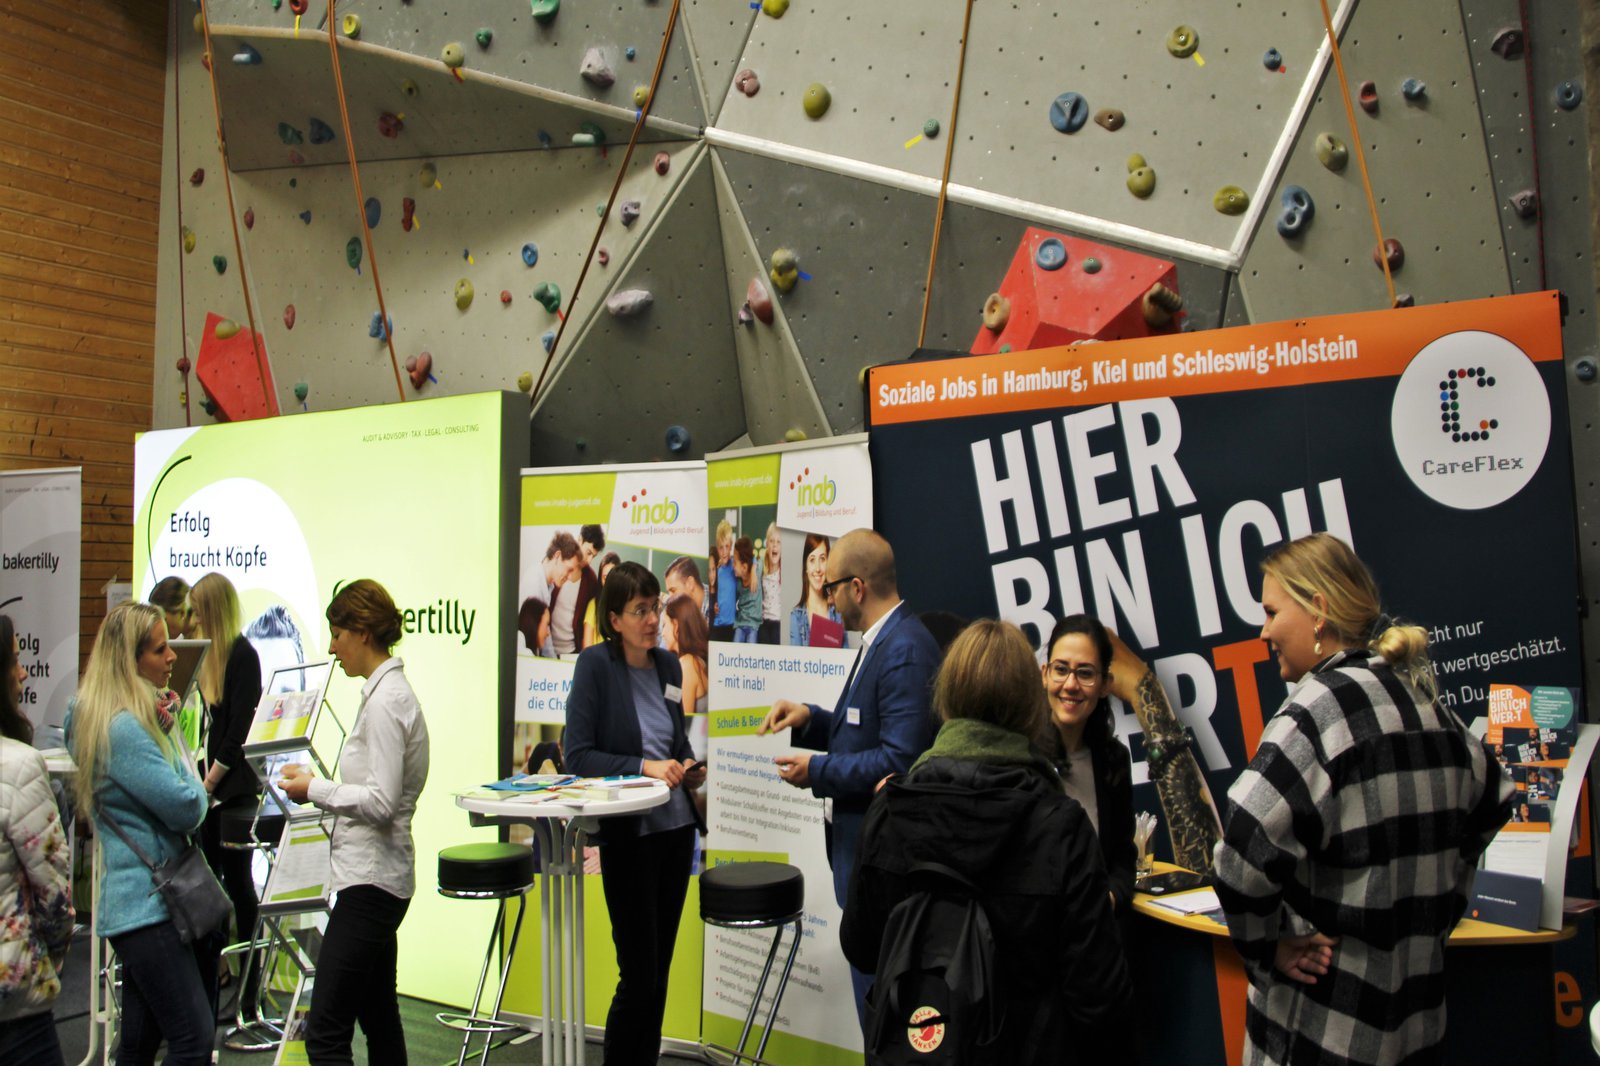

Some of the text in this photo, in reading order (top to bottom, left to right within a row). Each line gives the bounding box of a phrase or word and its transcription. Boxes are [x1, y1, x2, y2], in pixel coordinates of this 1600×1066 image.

[879, 335, 1358, 407] Soziale Jobs in Hamburg, Kiel und Schleswig-Holstein
[383, 431, 408, 441] ADVISORY
[411, 430, 421, 438] TAX
[425, 428, 441, 437] LEGAL
[445, 424, 479, 435] CONSULTING
[971, 397, 1197, 554] HIER
[1422, 455, 1524, 476] CareFlex
[797, 474, 836, 507] inab
[631, 496, 679, 524] inab
[171, 510, 210, 538] Erfolg
[629, 526, 650, 536] Jugend
[653, 526, 674, 536] Bildung
[674, 526, 686, 535] und
[2, 553, 60, 573] bakertilly
[170, 544, 267, 574] braucht Köpfe
[992, 530, 1159, 668] BIN
[403, 598, 476, 646] ertilly
[1427, 620, 1484, 643] cht nur
[1442, 636, 1566, 672] wertgeschätzt.
[718, 653, 845, 678] Durchstarten statt stolpern
[528, 678, 558, 693] Jeder
[724, 675, 740, 689] mit
[743, 675, 765, 691] inab!
[528, 696, 545, 710] die
[1438, 684, 1490, 706] ch Du.
[1489, 688, 1513, 702] HIER
[1491, 698, 1527, 714] BIN ICH
[717, 715, 739, 729] Schule
[742, 715, 747, 728] &
[727, 763, 747, 775] Talente
[759, 770, 785, 783] Neigung
